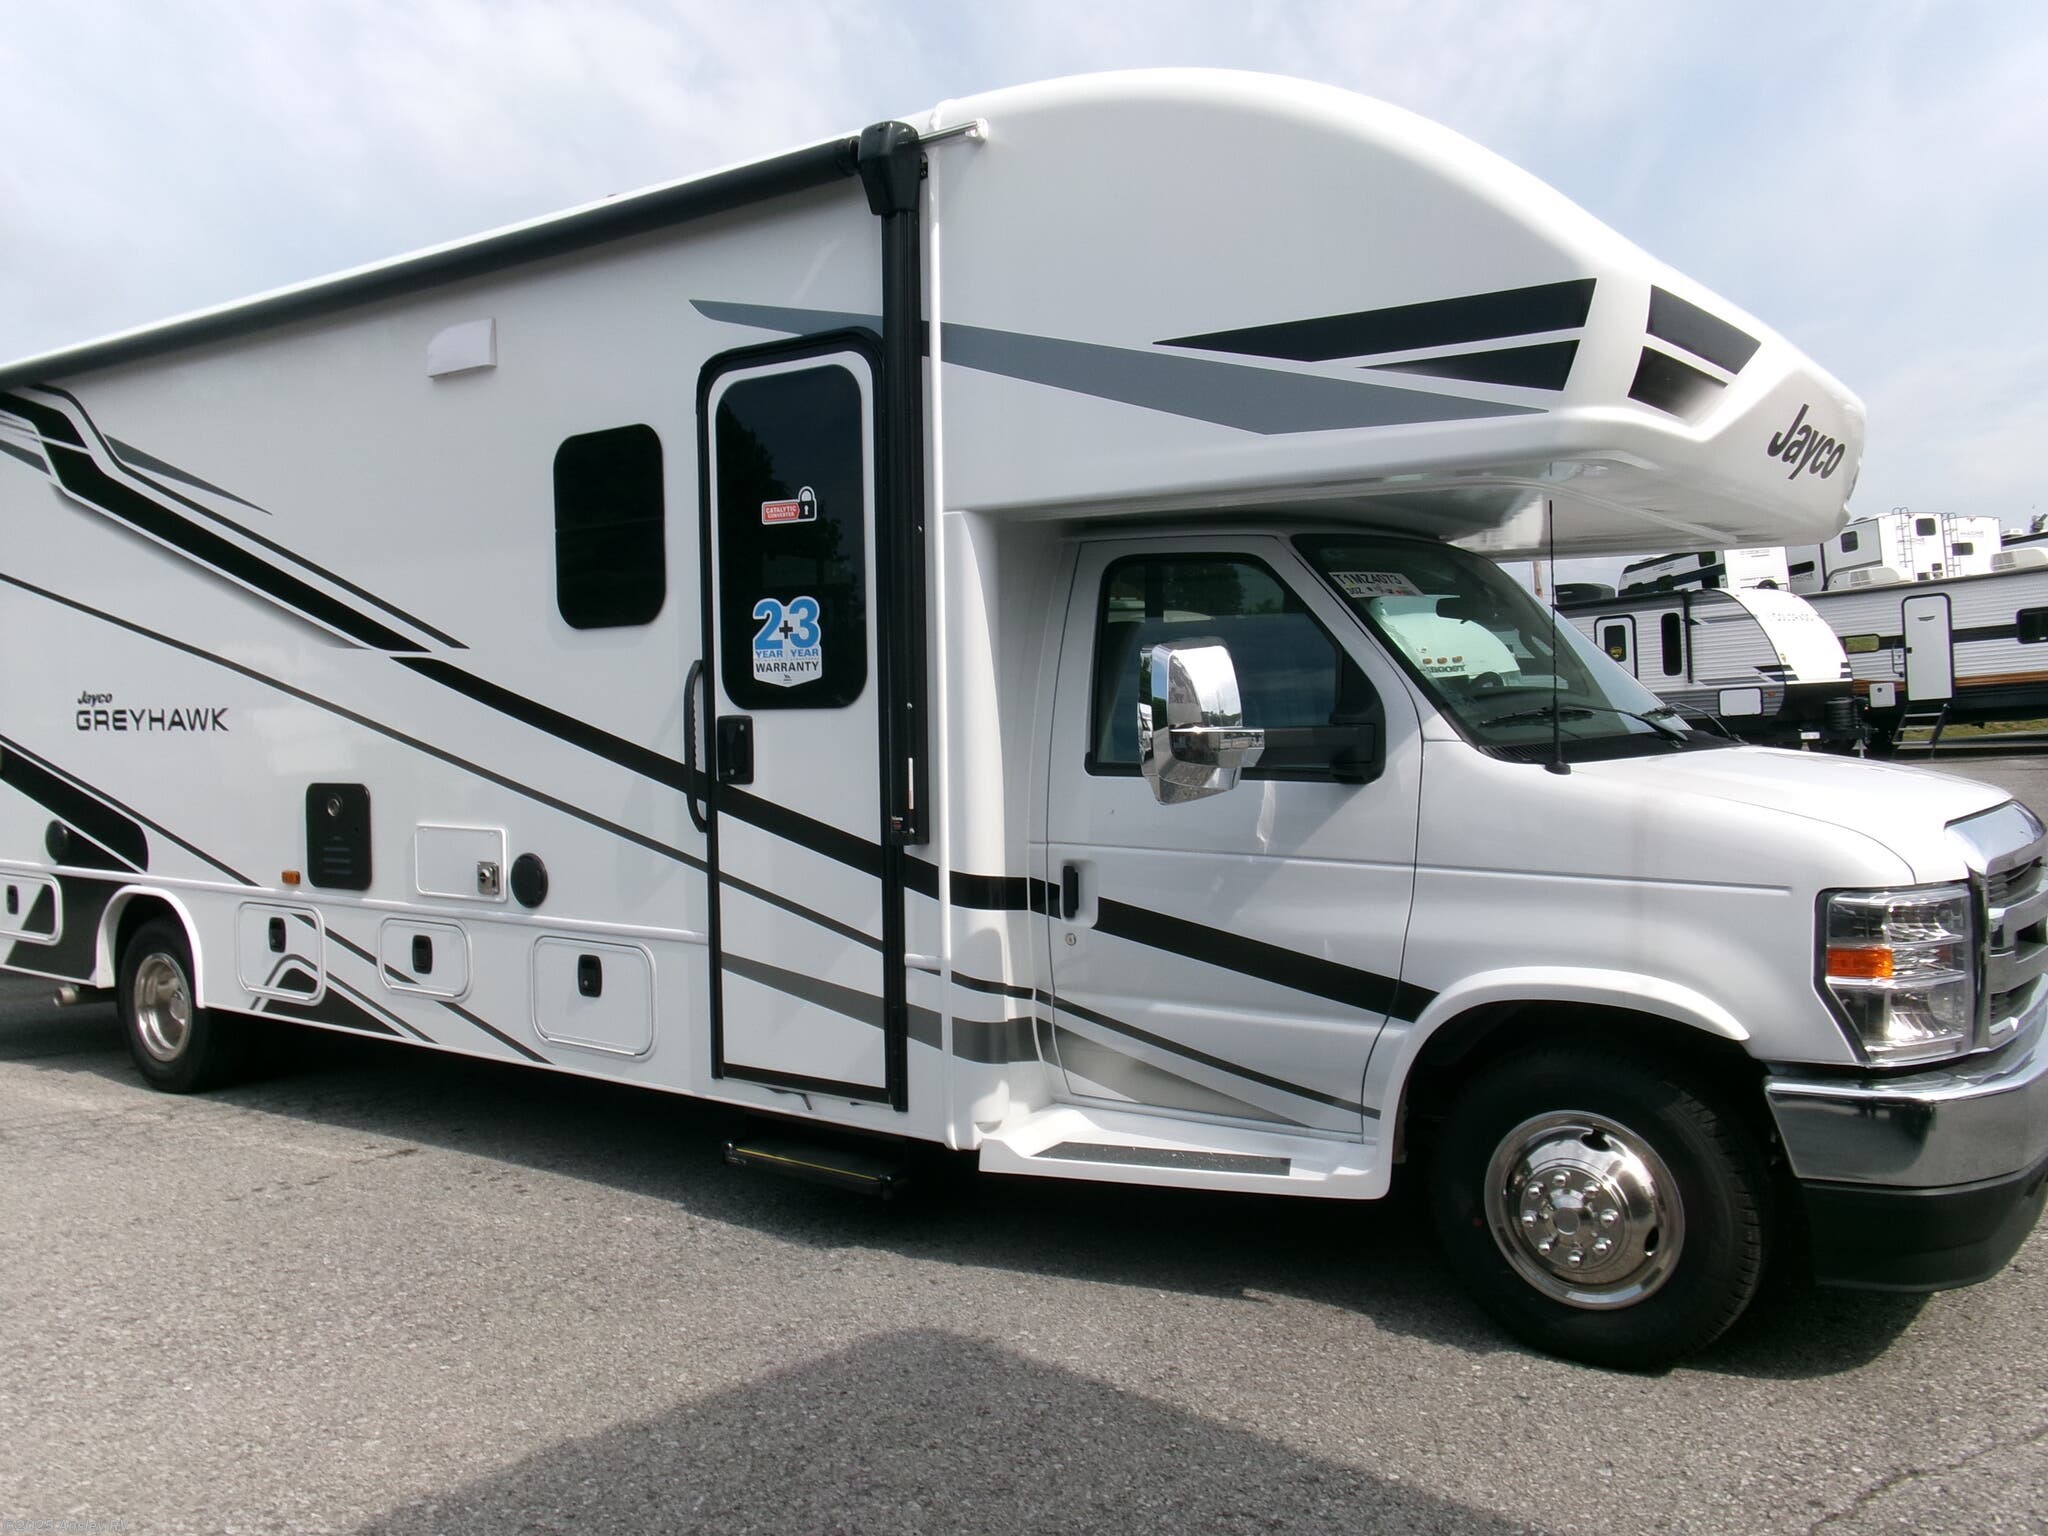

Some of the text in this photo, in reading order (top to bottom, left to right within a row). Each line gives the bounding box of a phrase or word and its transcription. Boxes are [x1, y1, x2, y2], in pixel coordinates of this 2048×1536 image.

[1767, 403, 1846, 480] Jayco
[765, 505, 797, 514] CATALYTIC
[755, 648, 819, 659] YEAR YEAR
[755, 661, 819, 673] WARRANTY
[77, 691, 113, 707] Jayco
[76, 708, 229, 731] GREYHAWK
